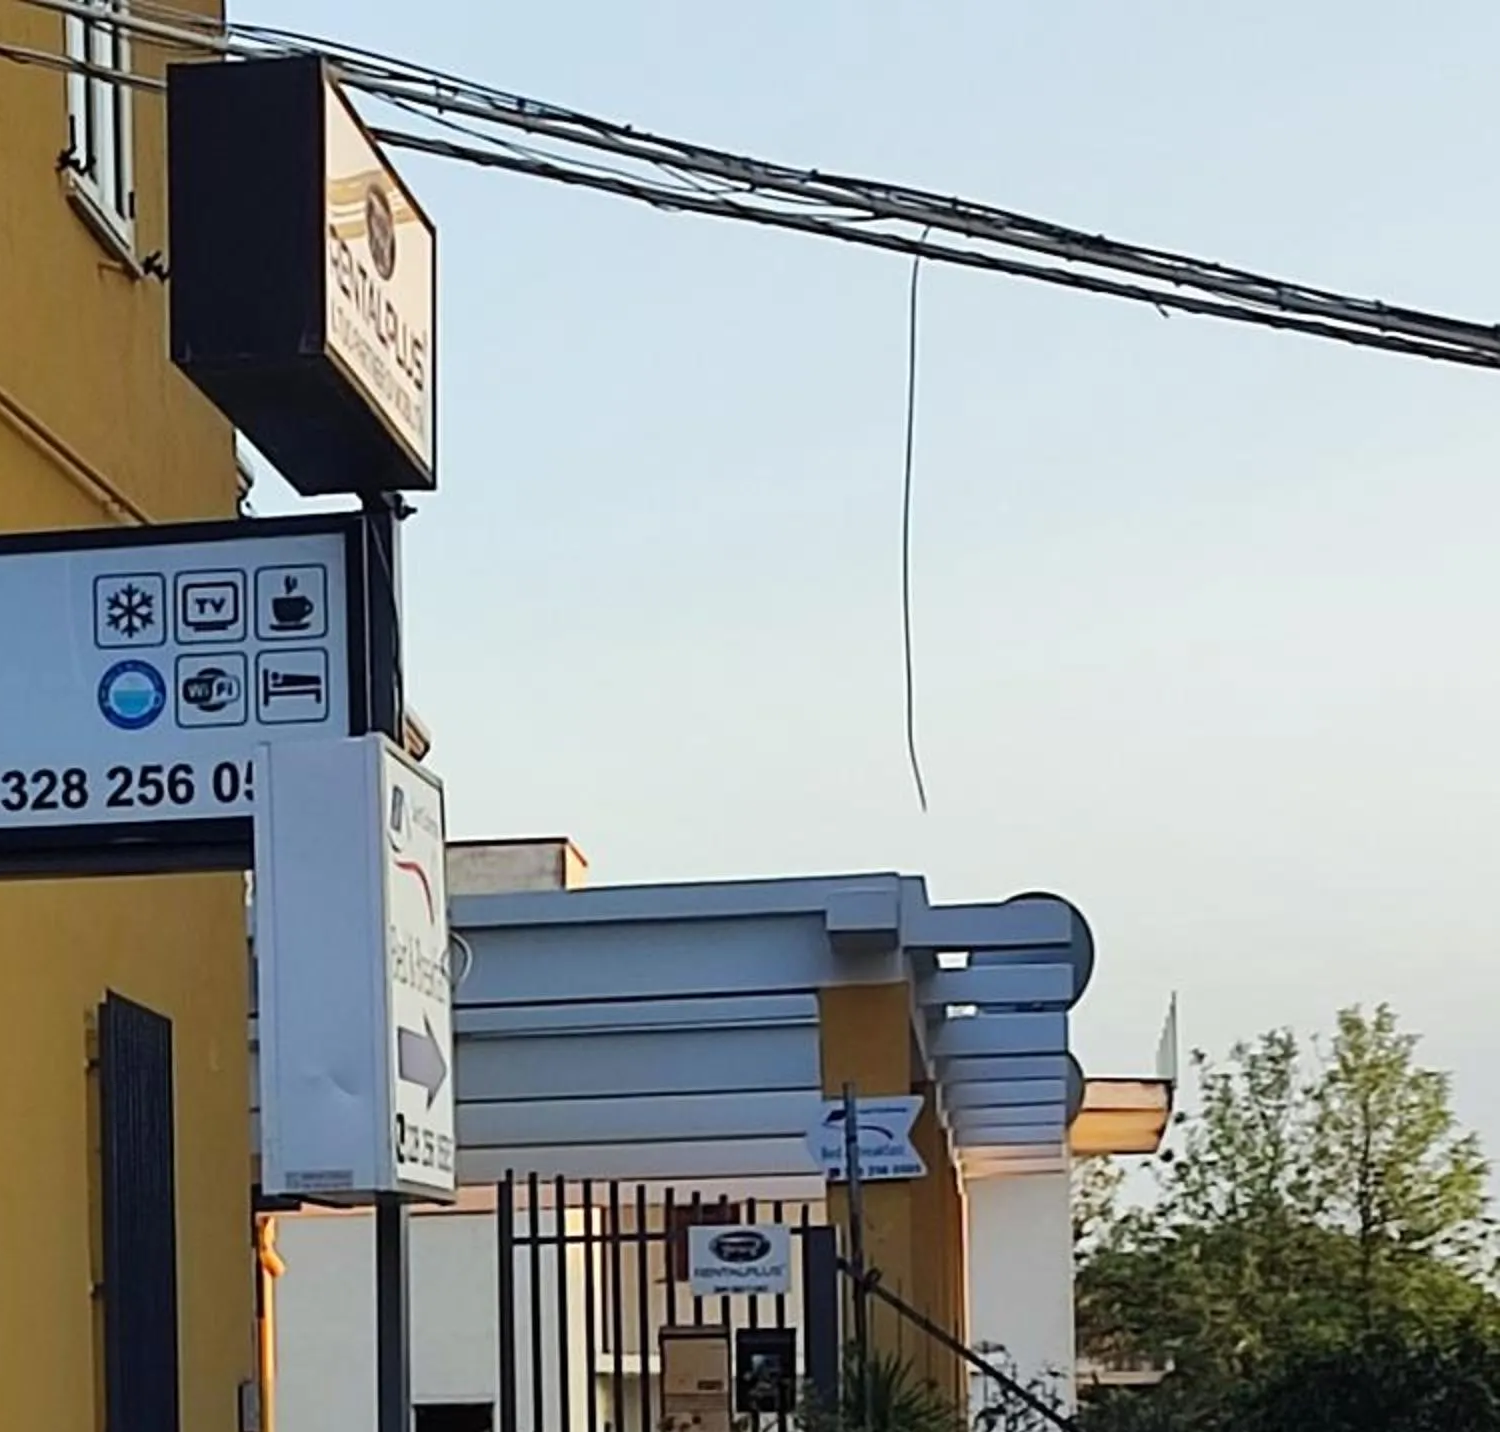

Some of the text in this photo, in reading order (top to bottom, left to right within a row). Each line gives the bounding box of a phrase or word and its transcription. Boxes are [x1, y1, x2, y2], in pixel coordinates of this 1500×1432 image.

[194, 597, 226, 615] TV
[1, 767, 89, 812] 328
[106, 763, 195, 807] 256
